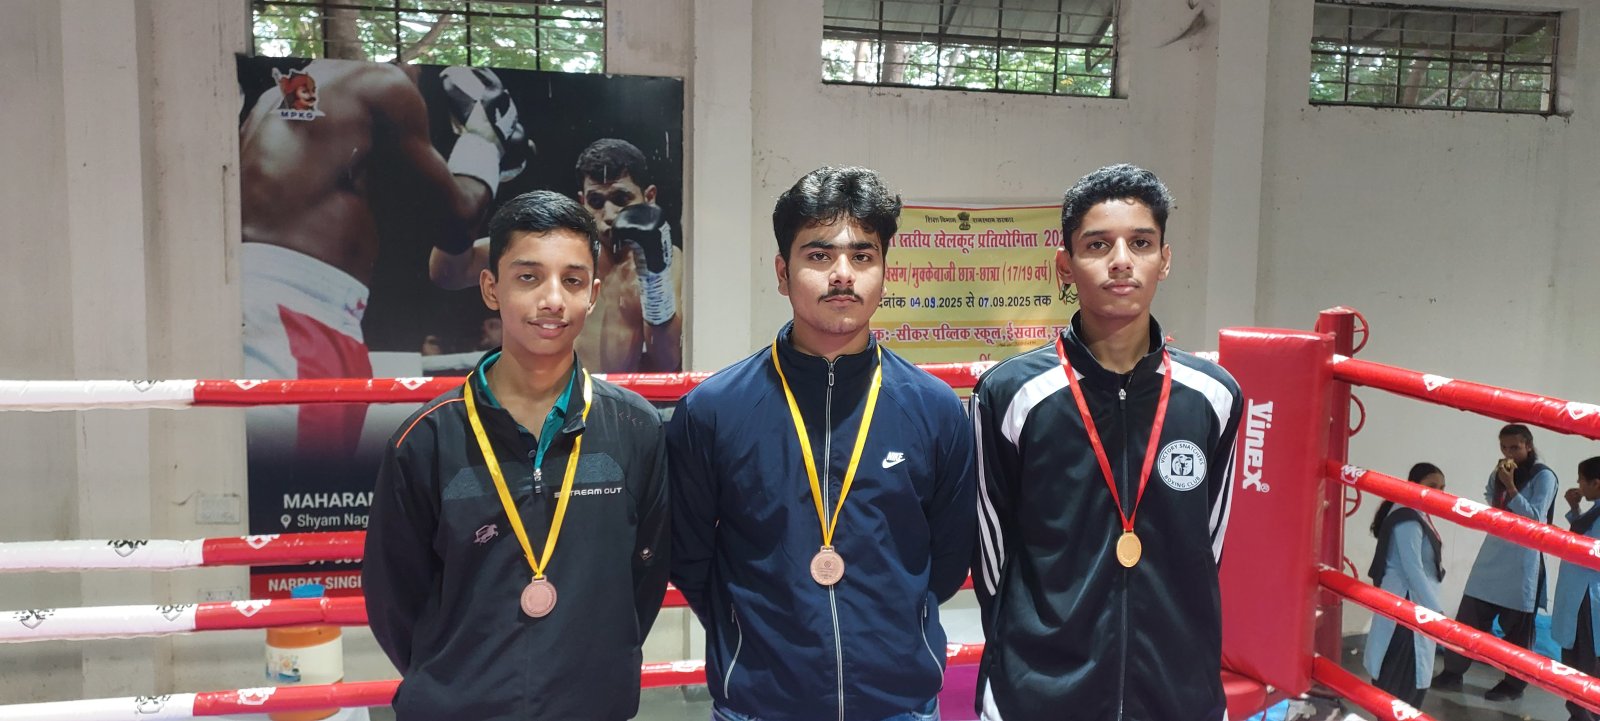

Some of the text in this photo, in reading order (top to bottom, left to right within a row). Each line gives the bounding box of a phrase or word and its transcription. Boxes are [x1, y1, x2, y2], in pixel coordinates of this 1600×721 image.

[281, 111, 313, 119] MPKG
[899, 230, 931, 248] स्तरीय
[934, 229, 975, 254] खेलकूद
[978, 229, 1038, 248] प्रतियोगिता
[1043, 229, 1065, 247] 202
[965, 291, 976, 308] से
[978, 296, 1031, 308] 07.09.2025
[1033, 295, 1052, 307] तक
[1161, 443, 1178, 464] VICTORY
[1242, 398, 1274, 492] Vinex
[1164, 474, 1201, 488] BOXING CLUB
[297, 513, 370, 530] Shyam Nag
